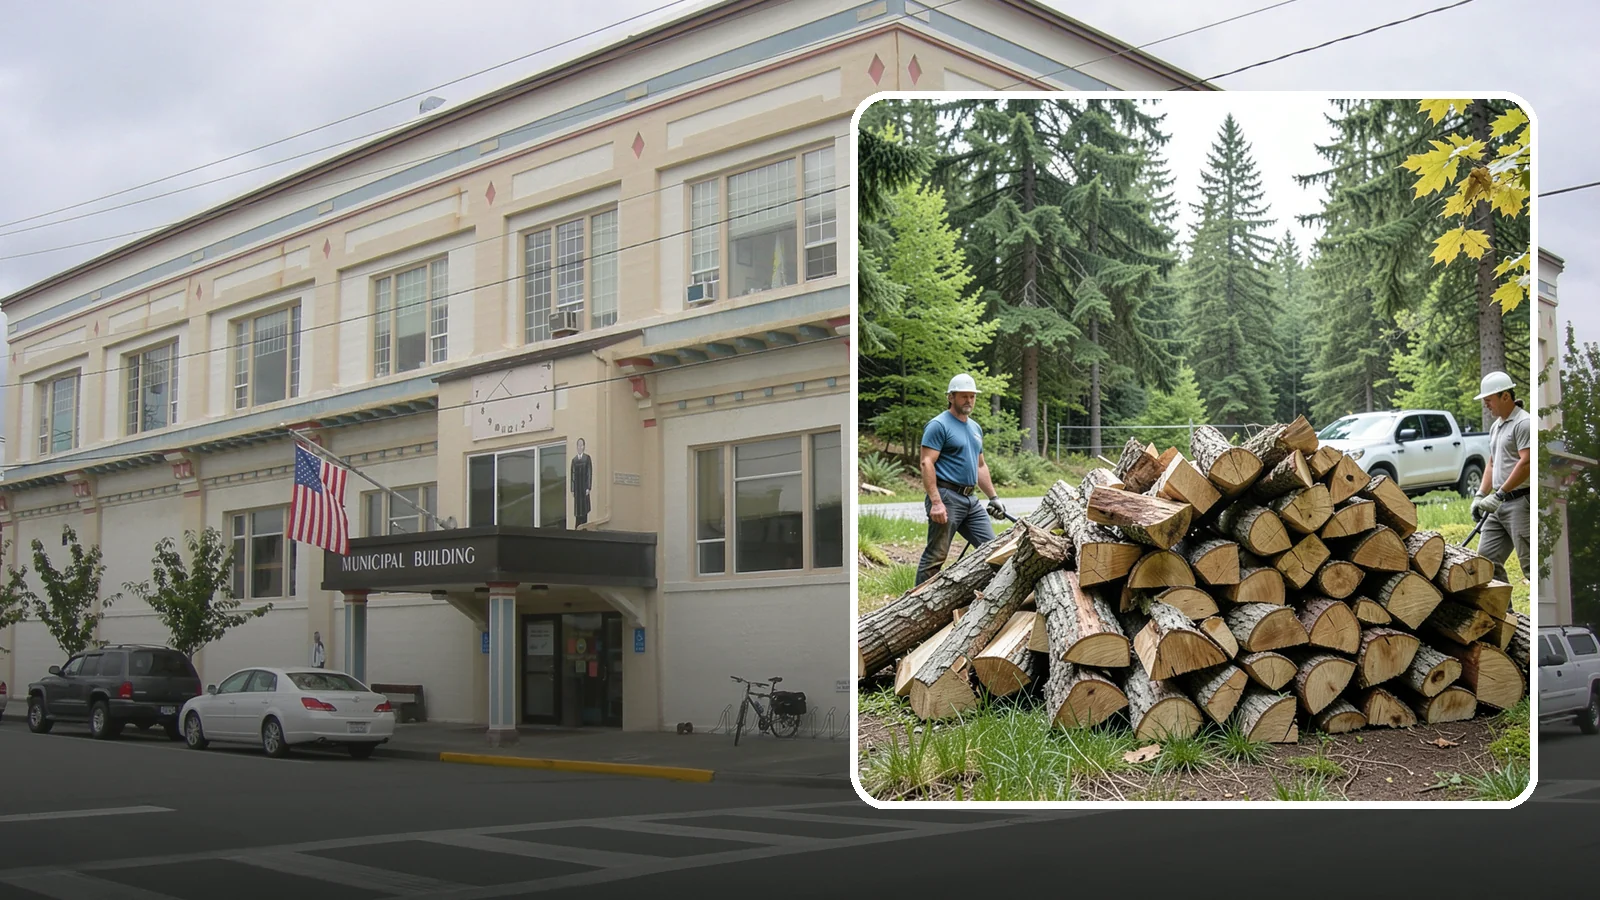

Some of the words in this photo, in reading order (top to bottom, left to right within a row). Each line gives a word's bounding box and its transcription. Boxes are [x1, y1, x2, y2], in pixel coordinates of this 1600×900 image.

[475, 390, 479, 398] 7
[536, 402, 540, 410] 4
[480, 406, 485, 415] 8
[487, 417, 492, 426] 9
[529, 413, 533, 422] 3
[495, 423, 500, 432] 10
[521, 420, 525, 428] 2
[501, 425, 506, 433] 11
[508, 425, 513, 433] 12
[342, 552, 405, 572] MUNICIPAL
[414, 546, 475, 567] BUILDING
